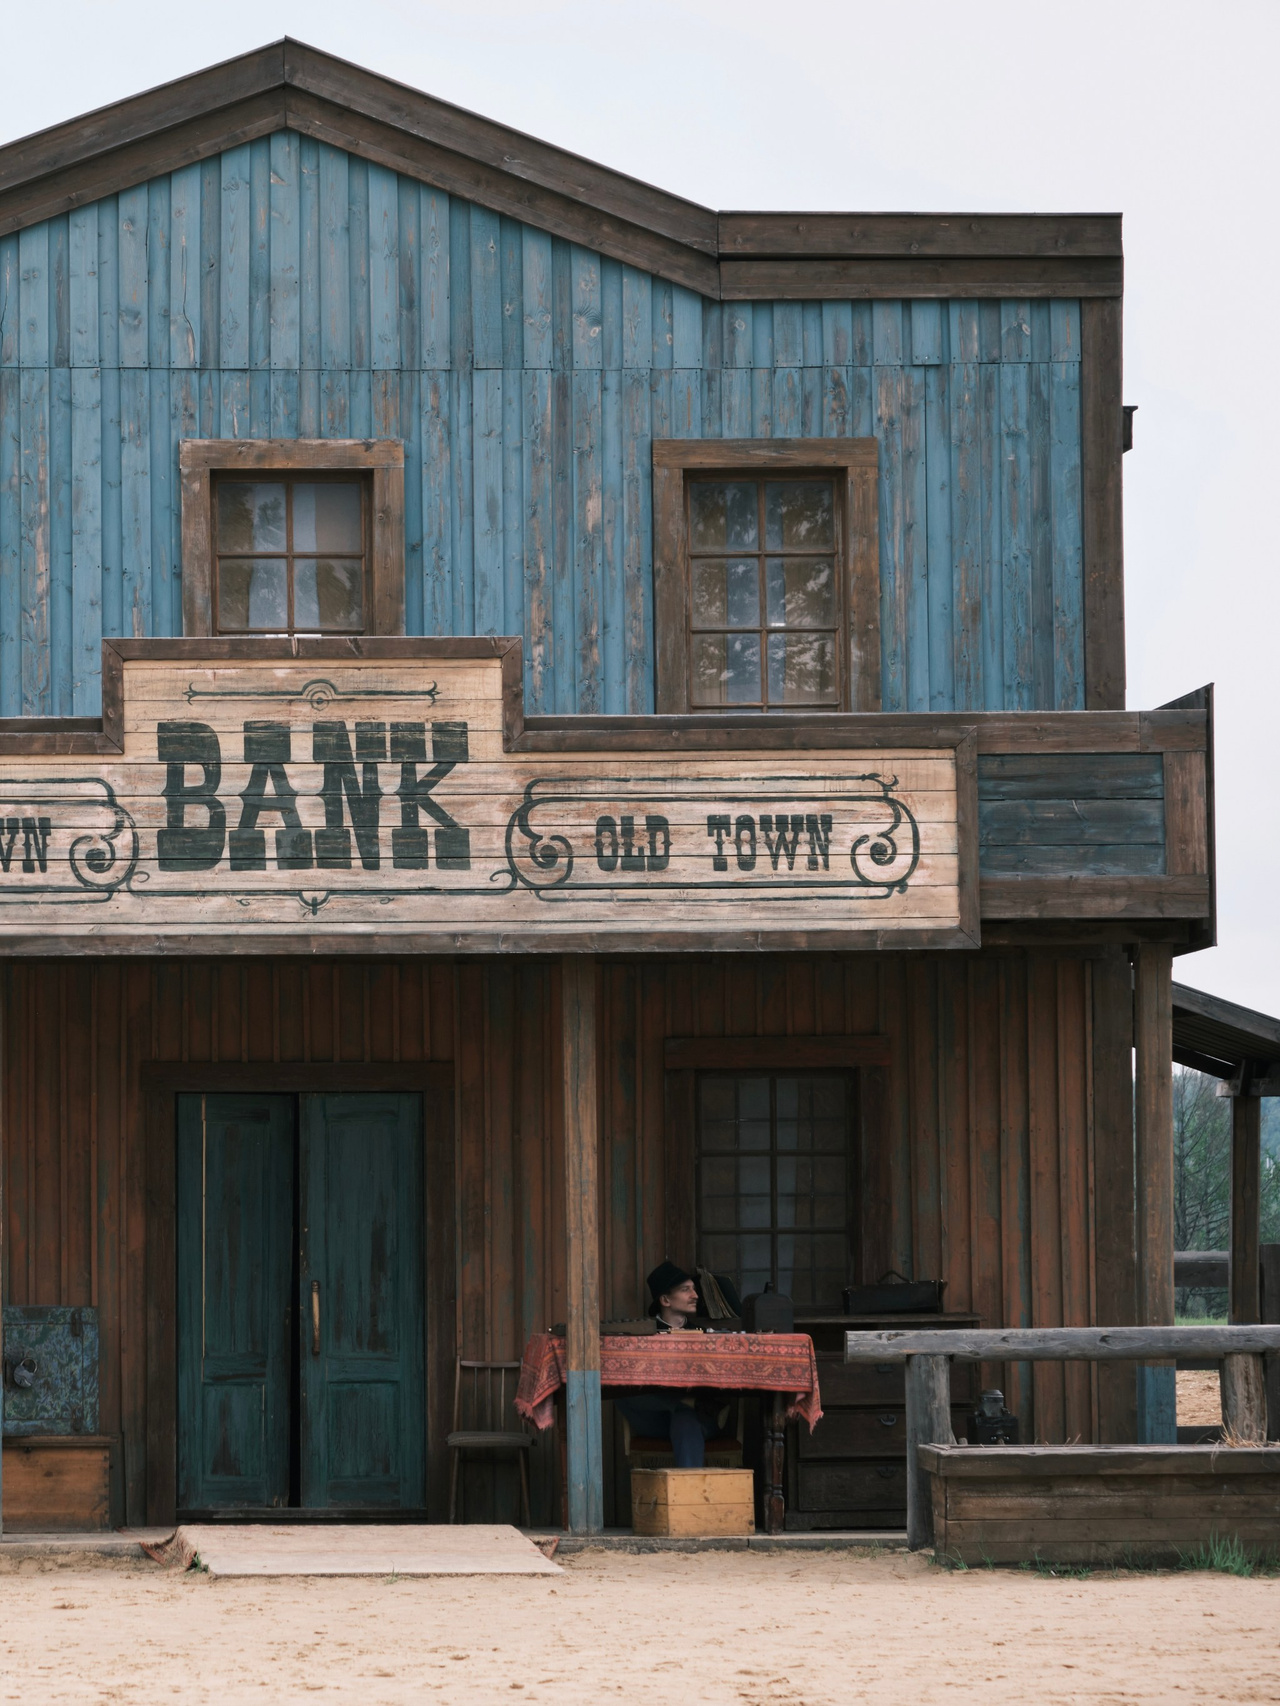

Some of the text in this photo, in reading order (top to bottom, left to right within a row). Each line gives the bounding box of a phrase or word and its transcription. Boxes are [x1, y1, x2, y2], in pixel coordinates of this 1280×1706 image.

[156, 720, 471, 872] BANK
[593, 813, 833, 872] OLD TOWN
